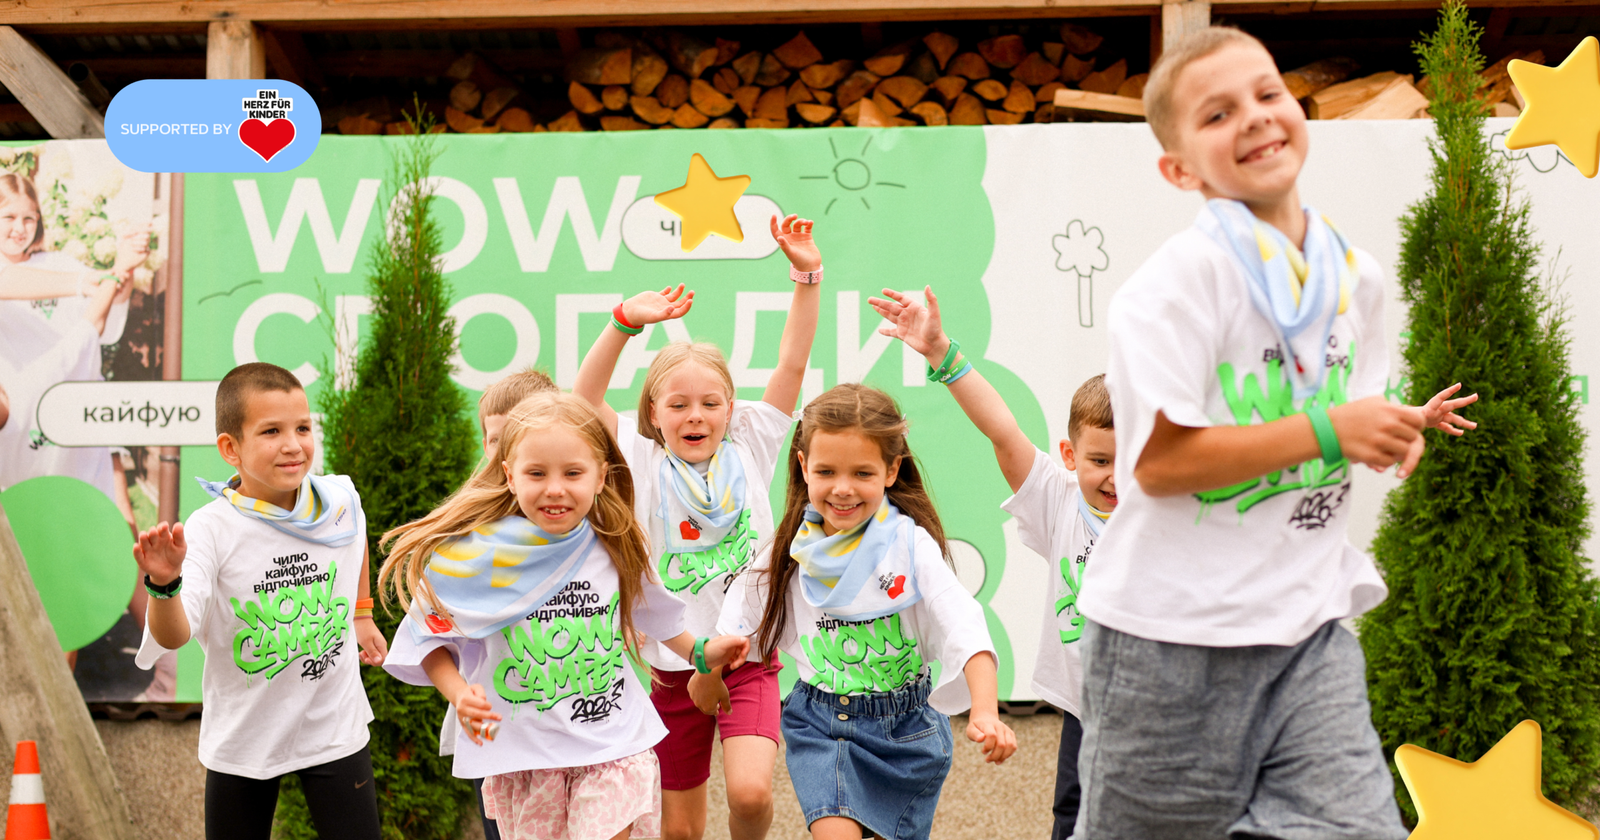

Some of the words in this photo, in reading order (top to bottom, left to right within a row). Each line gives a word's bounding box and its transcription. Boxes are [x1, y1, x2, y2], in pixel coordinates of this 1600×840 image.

[233, 174, 642, 274] WOW
[83, 400, 201, 427] кайфую
[265, 562, 318, 580] кайфую
[272, 552, 309, 567] чилю
[230, 560, 337, 630] WOW
[253, 572, 331, 593] відпочиваю
[563, 580, 591, 592] лю
[233, 597, 350, 680] CAMPER
[501, 591, 620, 665] WOW
[800, 612, 905, 672] WOW
